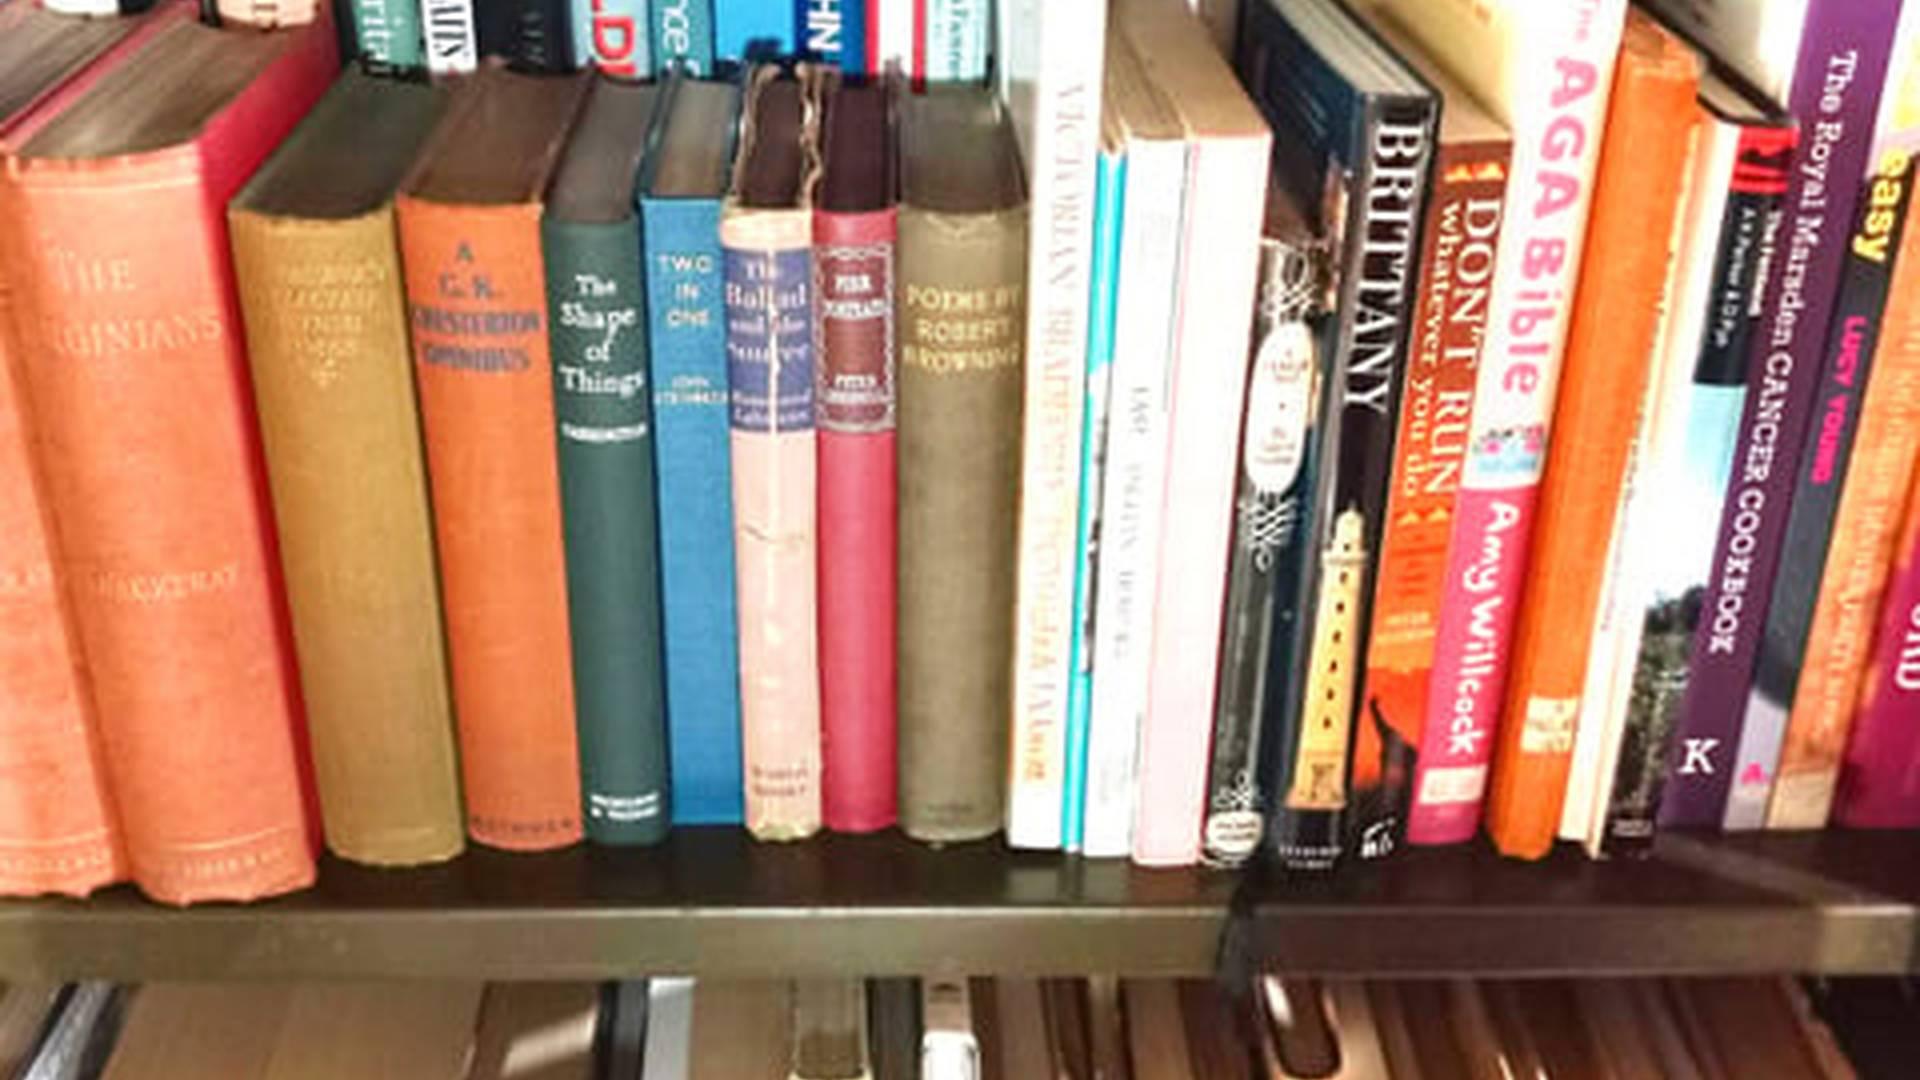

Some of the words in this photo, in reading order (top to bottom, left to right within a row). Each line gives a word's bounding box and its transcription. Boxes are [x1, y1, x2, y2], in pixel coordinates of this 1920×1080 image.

[1819, 50, 1858, 114] The
[1533, 56, 1598, 219] AGA
[1799, 120, 1844, 208] Royal
[1852, 149, 1912, 264] easy
[575, 274, 617, 296] The
[658, 255, 714, 274] TWO
[907, 285, 986, 311] POEMS
[1344, 122, 1425, 414] BRITTANY
[1421, 202, 1461, 367] whatever
[1443, 198, 1500, 369] DON'T
[1771, 215, 1825, 347] Marsden
[560, 302, 636, 345] Shape
[667, 309, 710, 327] ONE
[916, 319, 1008, 343] ROBERT
[1502, 237, 1567, 395] Bible
[1835, 315, 1868, 388] LUCY
[559, 364, 655, 398] Things
[1407, 379, 1433, 441] you
[1743, 350, 1794, 483] CANCER
[1402, 452, 1423, 497] do
[1424, 390, 1472, 495] RUN
[1809, 394, 1847, 485] YOUNG
[1462, 501, 1520, 593] Amy
[1707, 487, 1766, 654] COOKBOOK
[1448, 595, 1502, 756] Willcock
[1677, 738, 1720, 774] K
